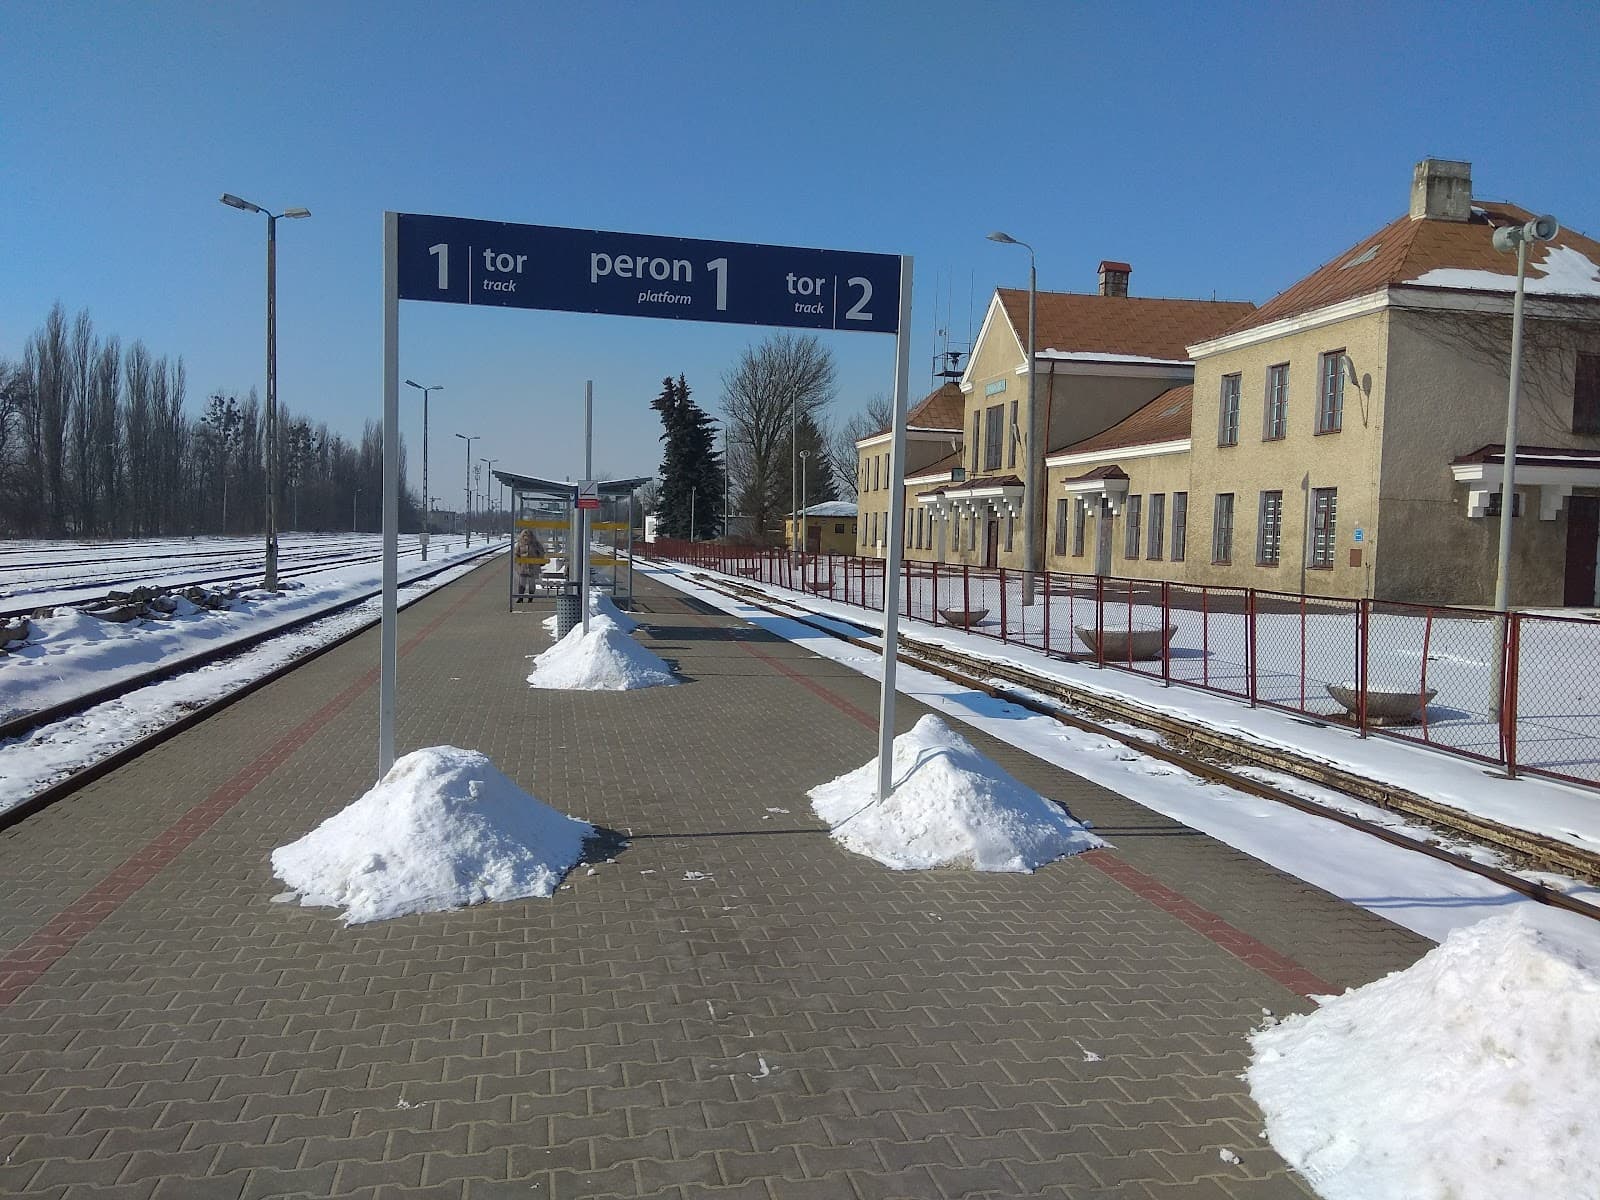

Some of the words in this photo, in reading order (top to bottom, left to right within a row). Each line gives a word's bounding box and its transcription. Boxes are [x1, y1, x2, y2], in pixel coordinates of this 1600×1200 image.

[428, 243, 448, 290] 1
[483, 248, 528, 274] tor
[590, 251, 692, 283] peron
[706, 257, 728, 311] 1
[483, 279, 517, 292] track
[637, 289, 692, 305] platform
[785, 272, 826, 296] tor
[845, 276, 874, 321] 2
[794, 302, 825, 314] track
